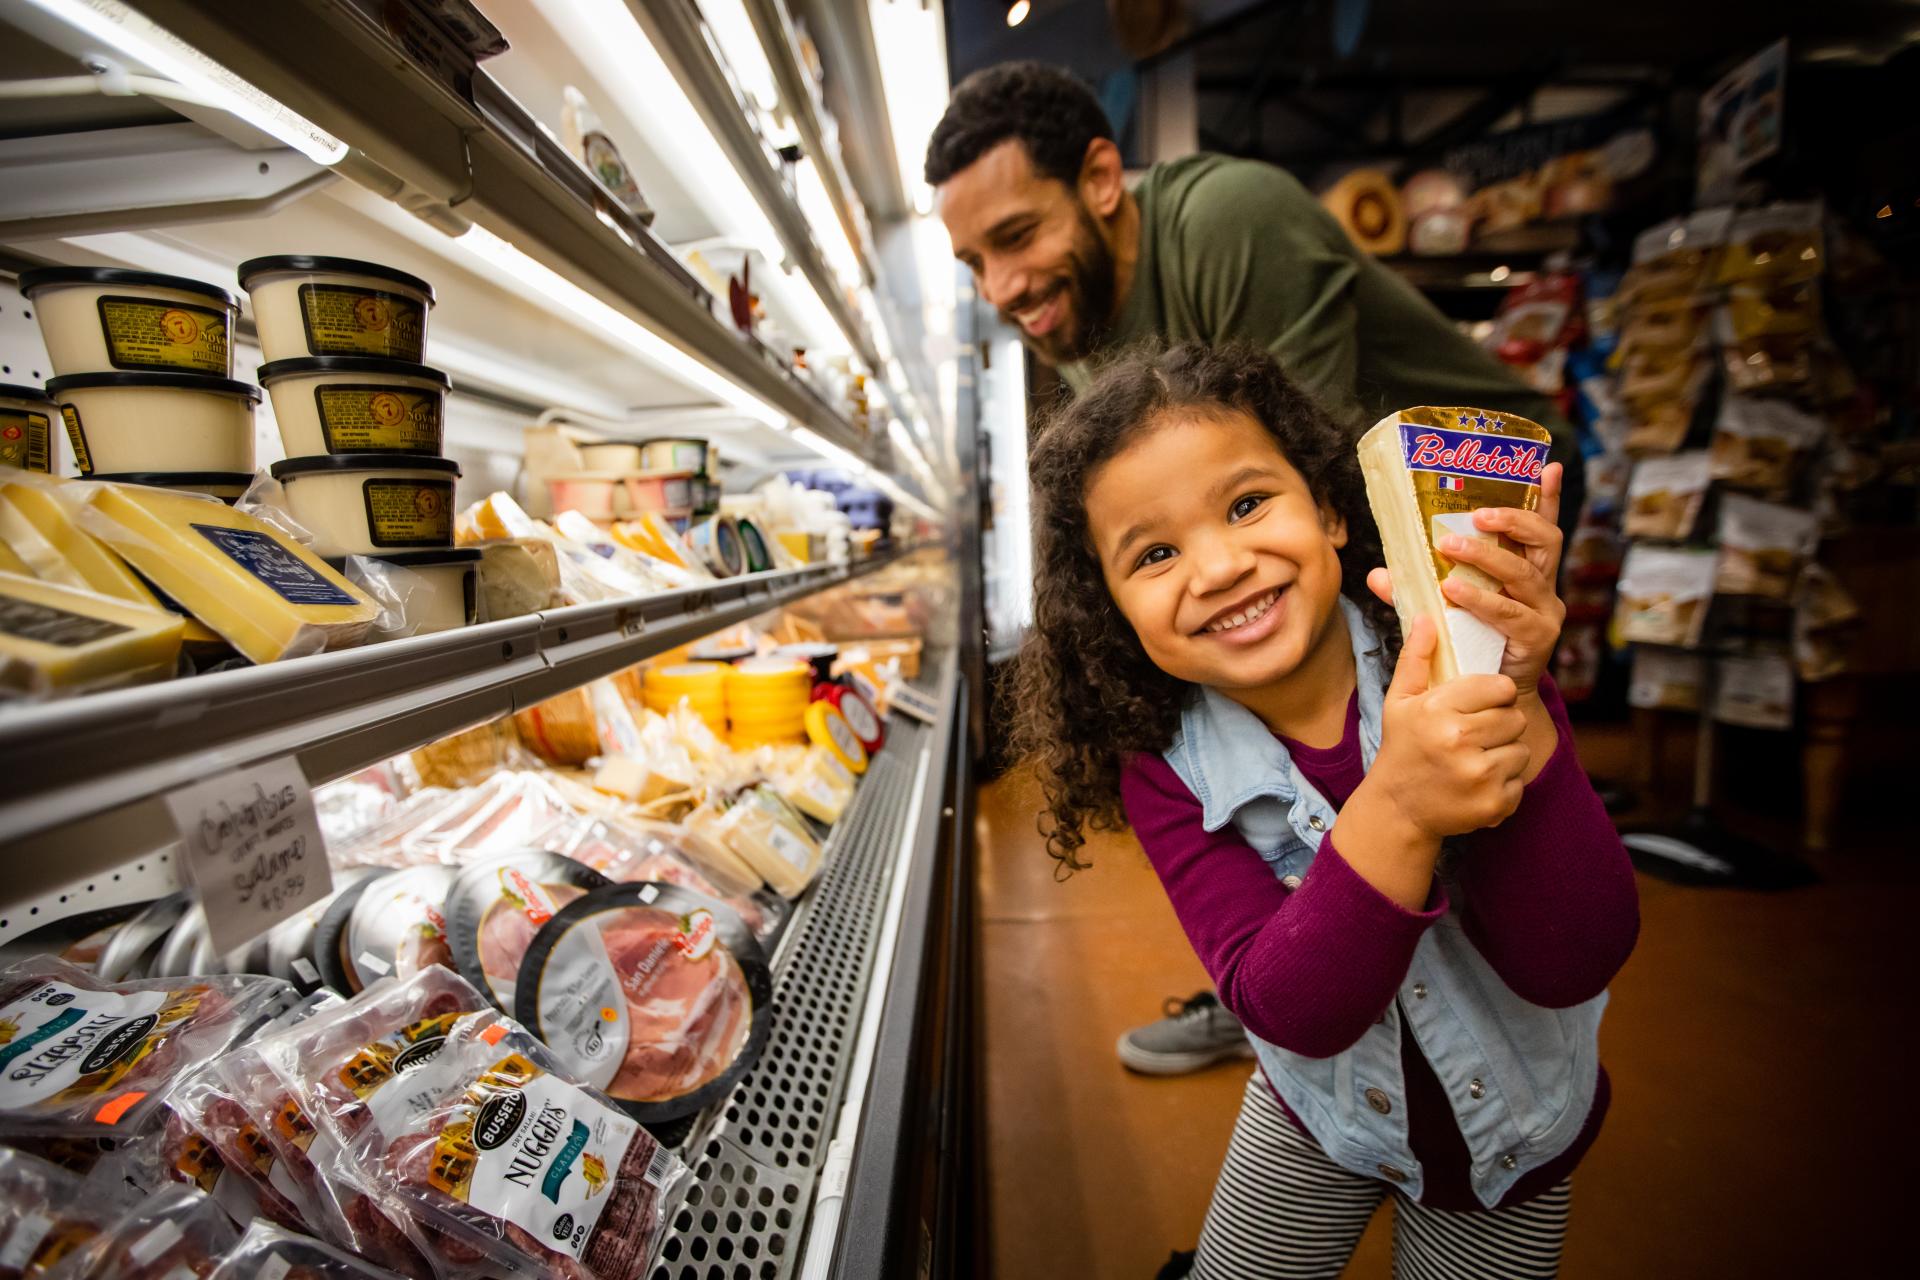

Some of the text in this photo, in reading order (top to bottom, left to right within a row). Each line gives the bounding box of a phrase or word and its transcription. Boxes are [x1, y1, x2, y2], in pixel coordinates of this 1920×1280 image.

[1410, 433, 1543, 480] Belletoile
[9, 1013, 127, 1084] NUGGETS
[88, 1018, 148, 1068] BUSSETO
[482, 1091, 521, 1145] BUSSETO
[511, 1110, 537, 1148] DRY SALAMI
[503, 1102, 567, 1189] NUGGETS
[551, 1135, 584, 1179] CLASSICO
[561, 1220, 573, 1238] FREE
